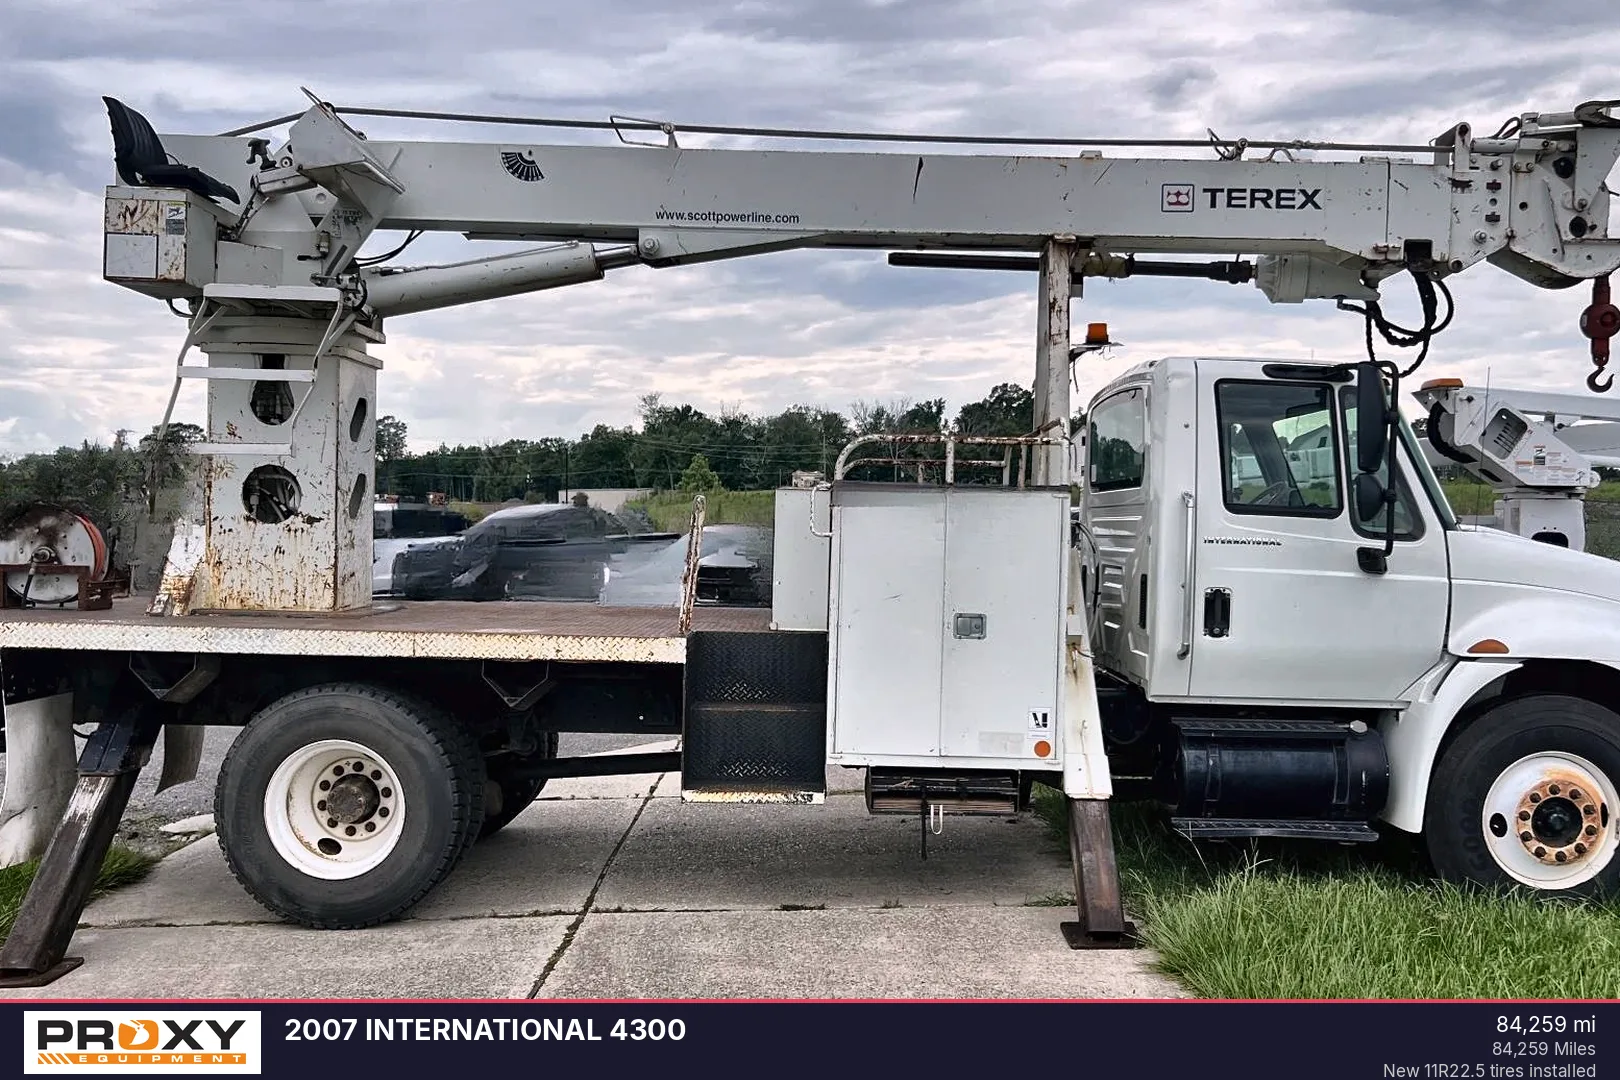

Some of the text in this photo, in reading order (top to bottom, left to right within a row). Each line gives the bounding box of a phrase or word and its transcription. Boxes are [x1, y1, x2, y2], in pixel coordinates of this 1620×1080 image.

[1202, 187, 1322, 210] TEREX
[655, 210, 800, 224] www.scottpowerline.com
[1203, 536, 1283, 547] INTERNATIONAL
